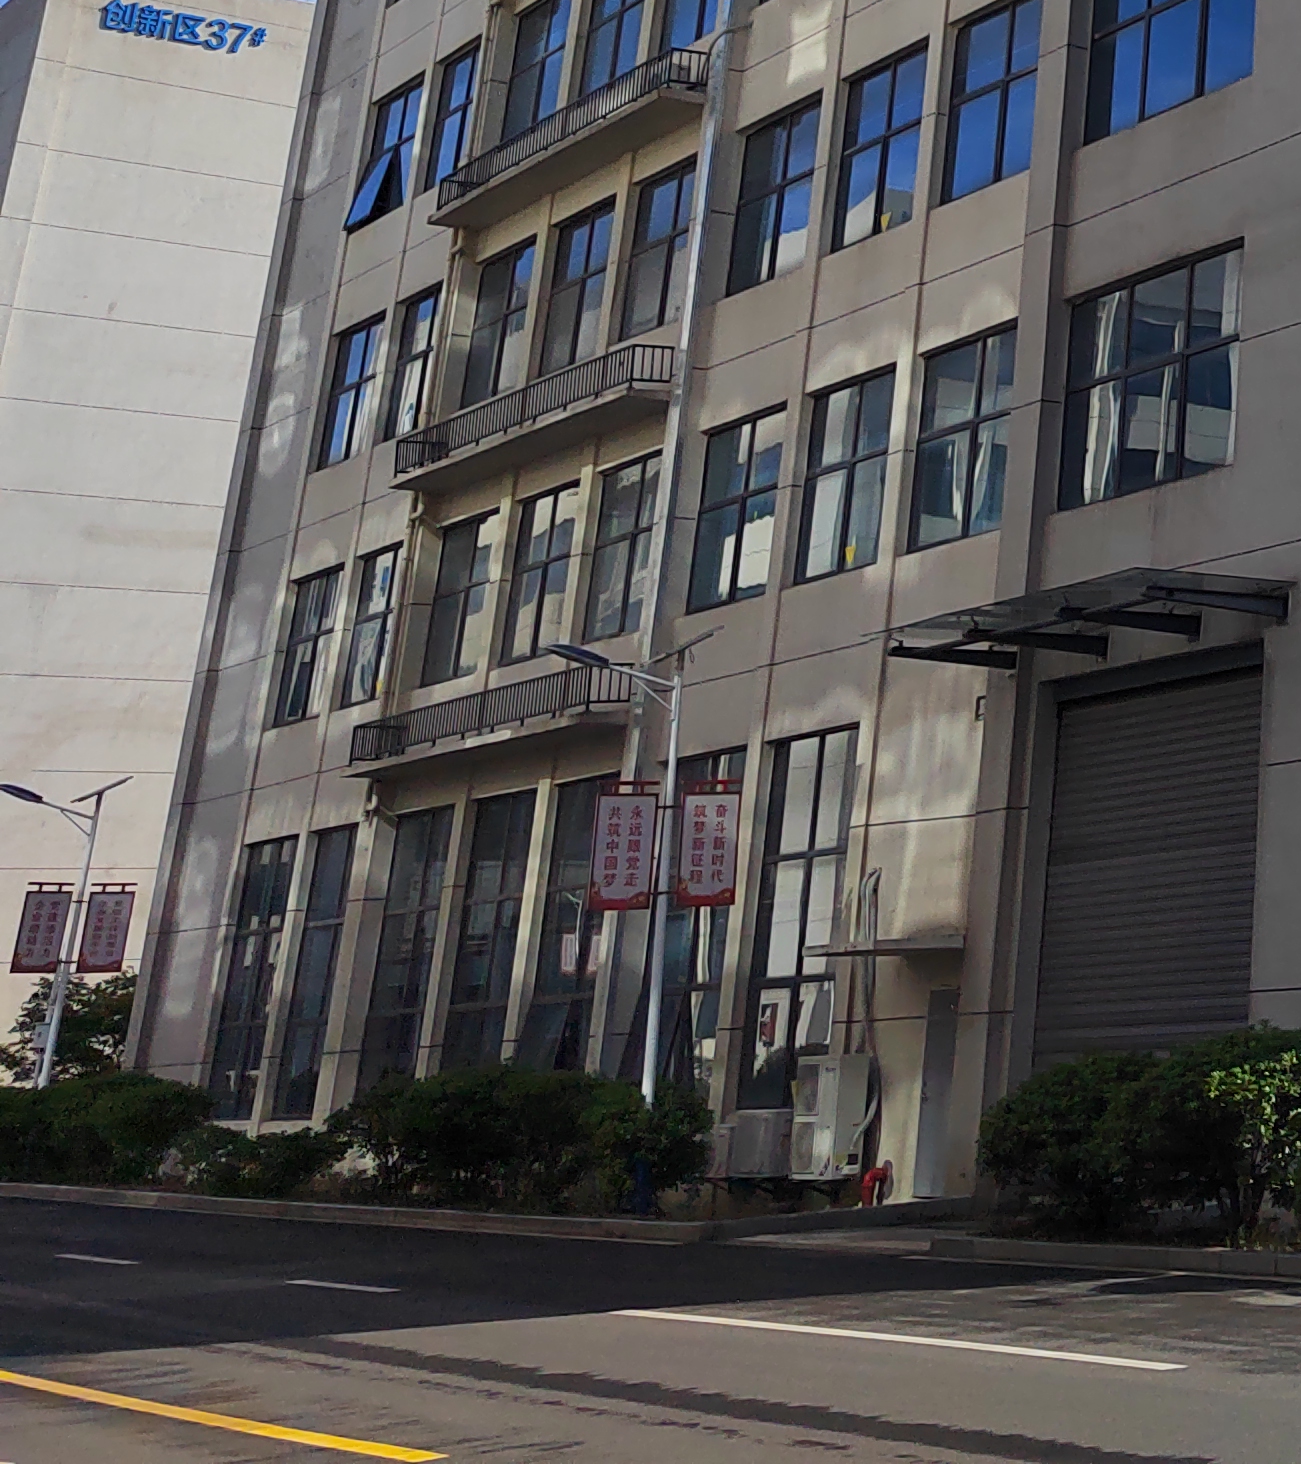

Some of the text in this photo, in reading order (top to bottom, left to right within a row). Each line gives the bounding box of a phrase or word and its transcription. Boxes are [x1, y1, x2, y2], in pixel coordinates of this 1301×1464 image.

[101, 0, 267, 53] 创新区37#
[602, 805, 622, 888] 共筑中国梦
[623, 805, 644, 887] 永远跟党走
[688, 804, 708, 885] 筑梦新征程
[711, 803, 729, 884] 奋斗新时代
